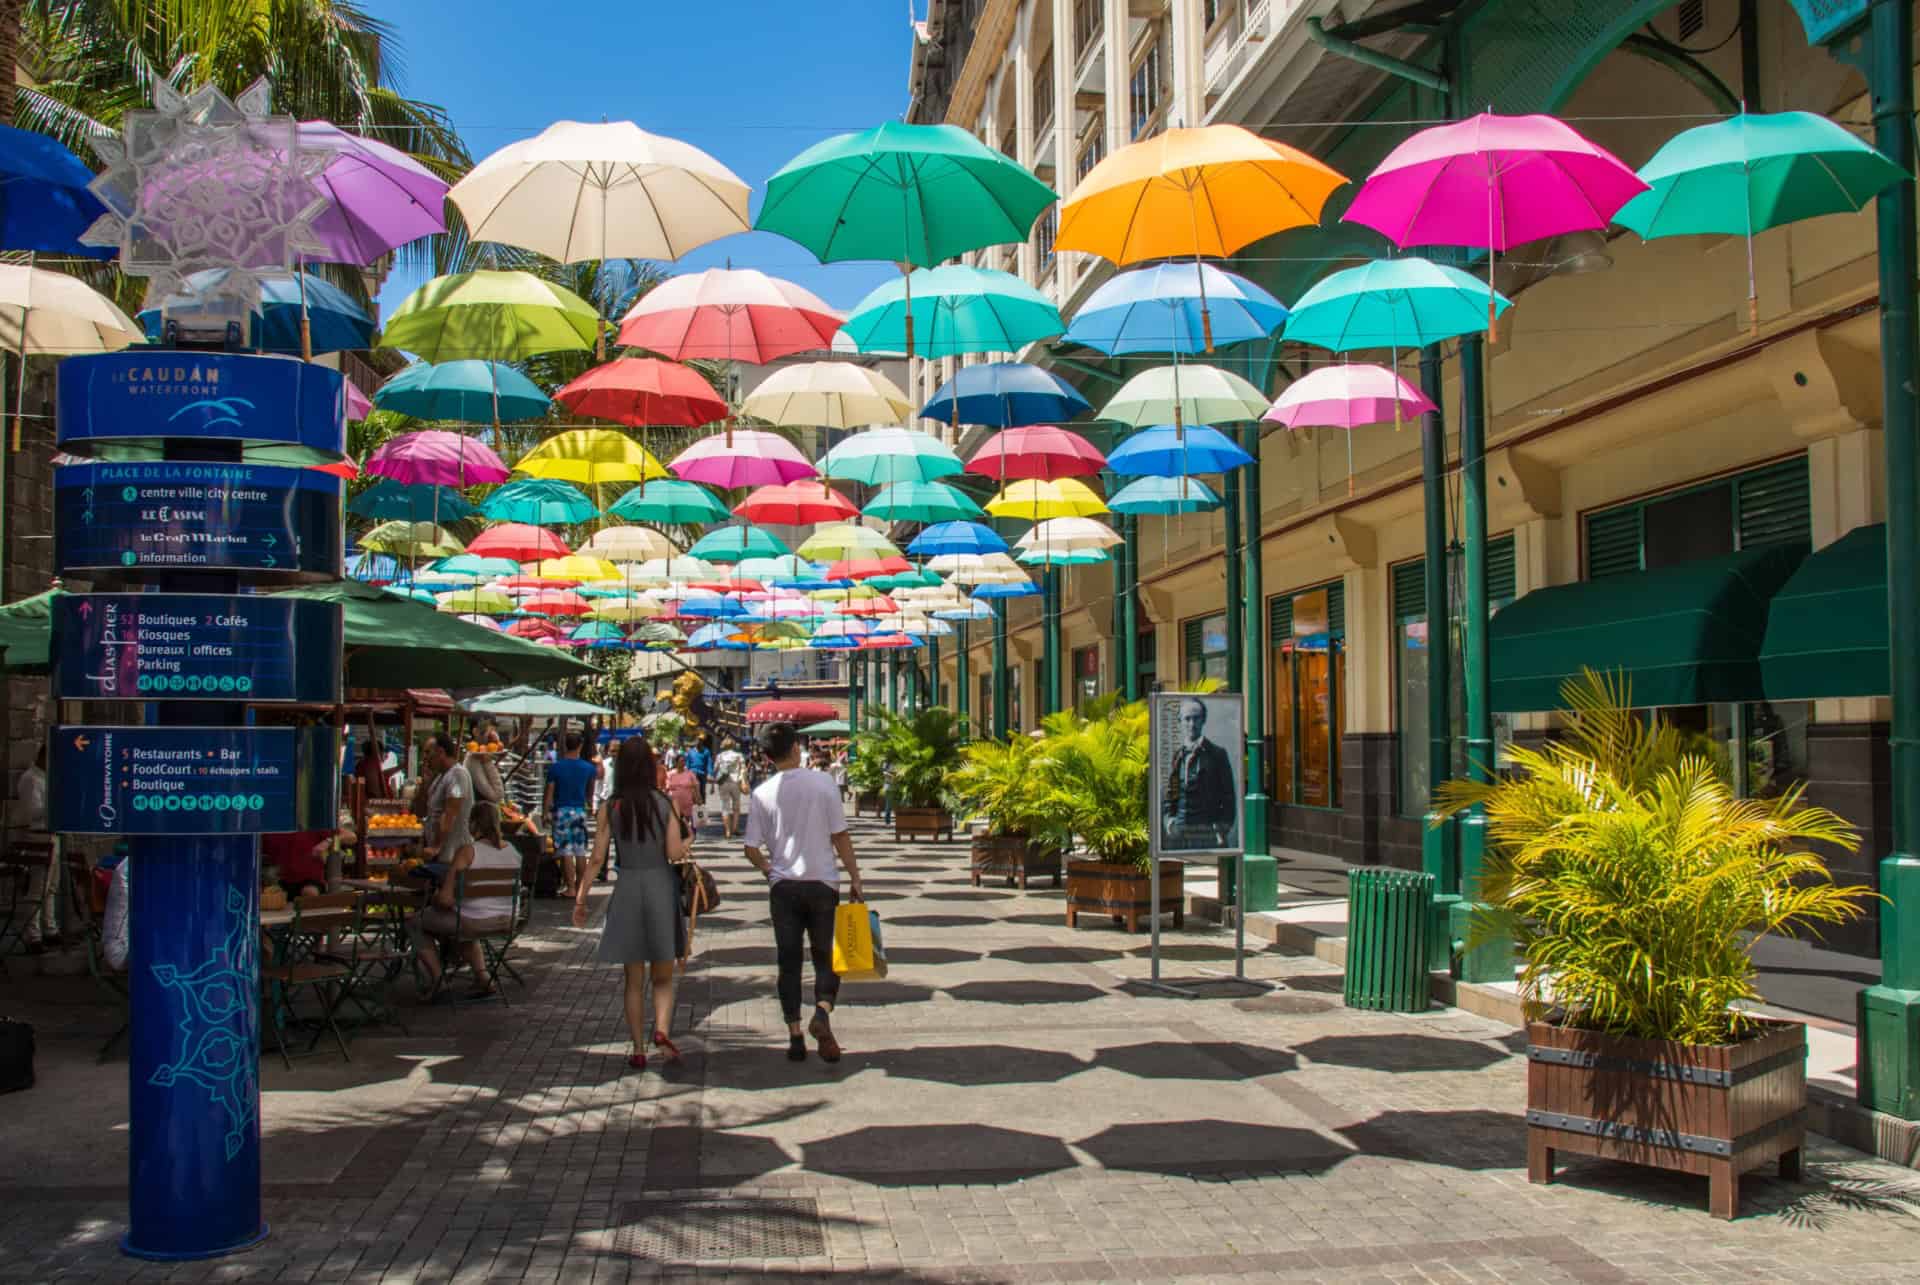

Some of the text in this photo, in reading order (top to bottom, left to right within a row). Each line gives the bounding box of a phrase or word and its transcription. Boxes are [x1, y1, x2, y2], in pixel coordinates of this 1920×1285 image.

[128, 367, 219, 384] CAUDAN
[129, 384, 219, 396] WATERFRONT
[101, 467, 254, 481] PLACE DE LA FONTAINE
[140, 486, 268, 502] centre ville city centre
[139, 551, 207, 564] information
[137, 613, 197, 627] Boutiques
[205, 615, 213, 626] 2
[215, 614, 249, 627] Cafés
[137, 628, 191, 642] Kiosques
[137, 644, 233, 657] Bureaux offices
[137, 658, 181, 673] Parking
[133, 748, 202, 760] Restaurants
[220, 748, 241, 760] Bar
[133, 763, 192, 776] FoodCourt
[132, 778, 185, 792] Boutique
